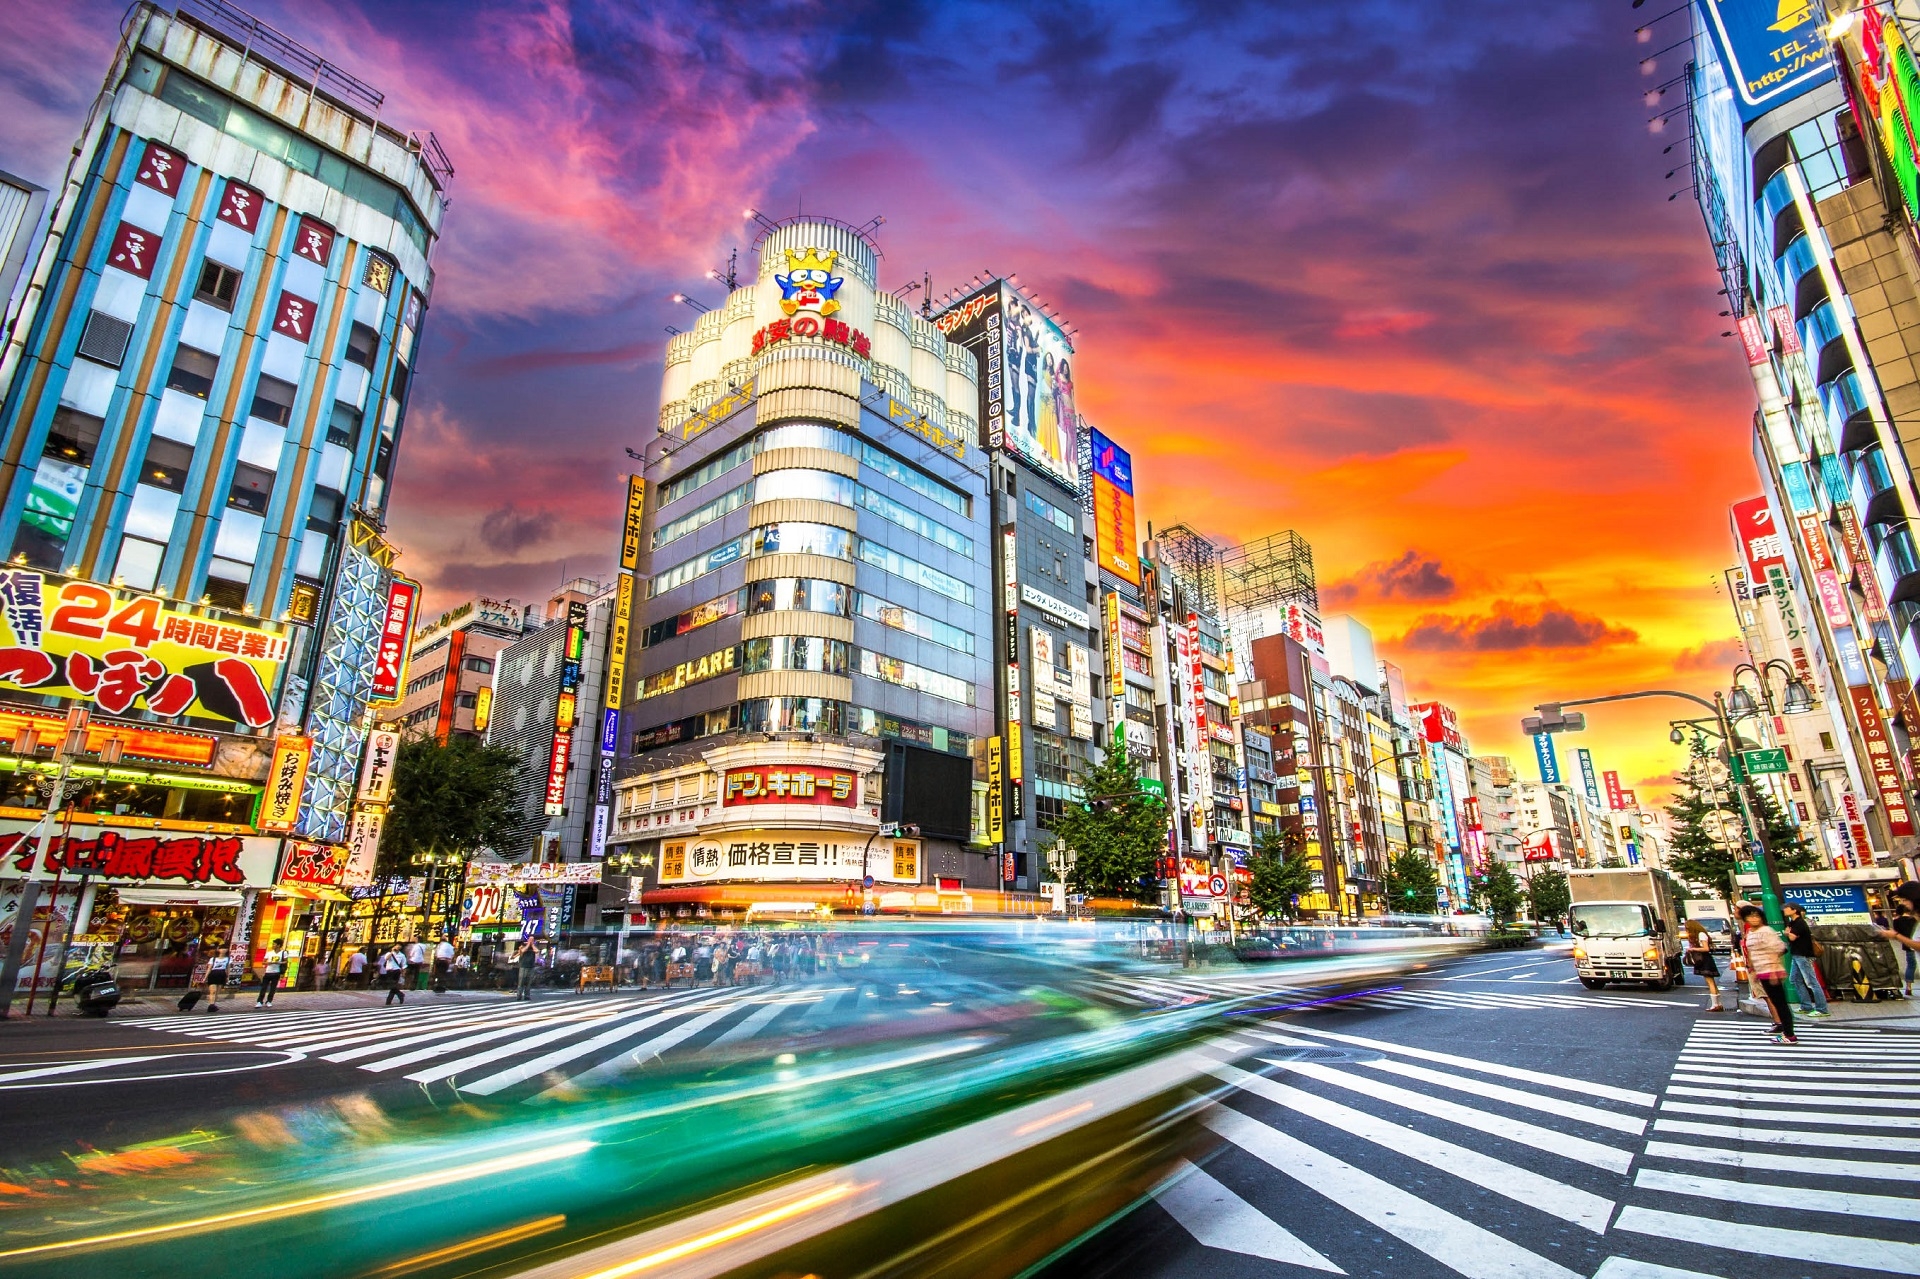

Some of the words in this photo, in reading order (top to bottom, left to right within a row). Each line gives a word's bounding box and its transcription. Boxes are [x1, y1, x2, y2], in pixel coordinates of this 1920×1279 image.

[751, 316, 872, 358] 激安の殿堂
[988, 313, 1003, 448] 進化型居酒屋の聖地
[1112, 488, 1125, 555] PROMISE
[387, 594, 408, 635] 居酒屋
[619, 578, 631, 617] ブランド品
[1025, 590, 1047, 604] エンタメ
[1048, 599, 1088, 622] レストランタワー
[1769, 568, 1800, 640] 新宿サンパーク
[480, 610, 521, 628] カプセル
[614, 625, 625, 656] 貴金属
[1188, 619, 1200, 664] カラオケ
[376, 642, 398, 678] つぼ八
[675, 647, 734, 685] FLARE
[0, 647, 276, 727] つぼ八
[609, 667, 621, 704] 高額買取
[1185, 662, 1197, 731] カラオケ
[1193, 674, 1206, 718] パセラ
[380, 723, 396, 732] 6F
[1191, 744, 1201, 798] パセラ
[1751, 751, 1780, 761] モア
[1753, 762, 1782, 771] 靖国通り
[1859, 698, 1909, 824] クスリの龍生堂薬局
[272, 752, 299, 818] お好み焼き
[990, 747, 1001, 832] ドン・キホーテ
[693, 847, 718, 868] 情熱
[728, 842, 837, 867] 価格宣言!!
[895, 846, 914, 858] 情熱
[895, 862, 914, 876] 価格
[471, 888, 500, 923] 270
[562, 886, 574, 922] カラオケ
[1785, 888, 1853, 899] SUBNADE
[521, 920, 538, 934] 747
[549, 907, 559, 938] カラオケ
